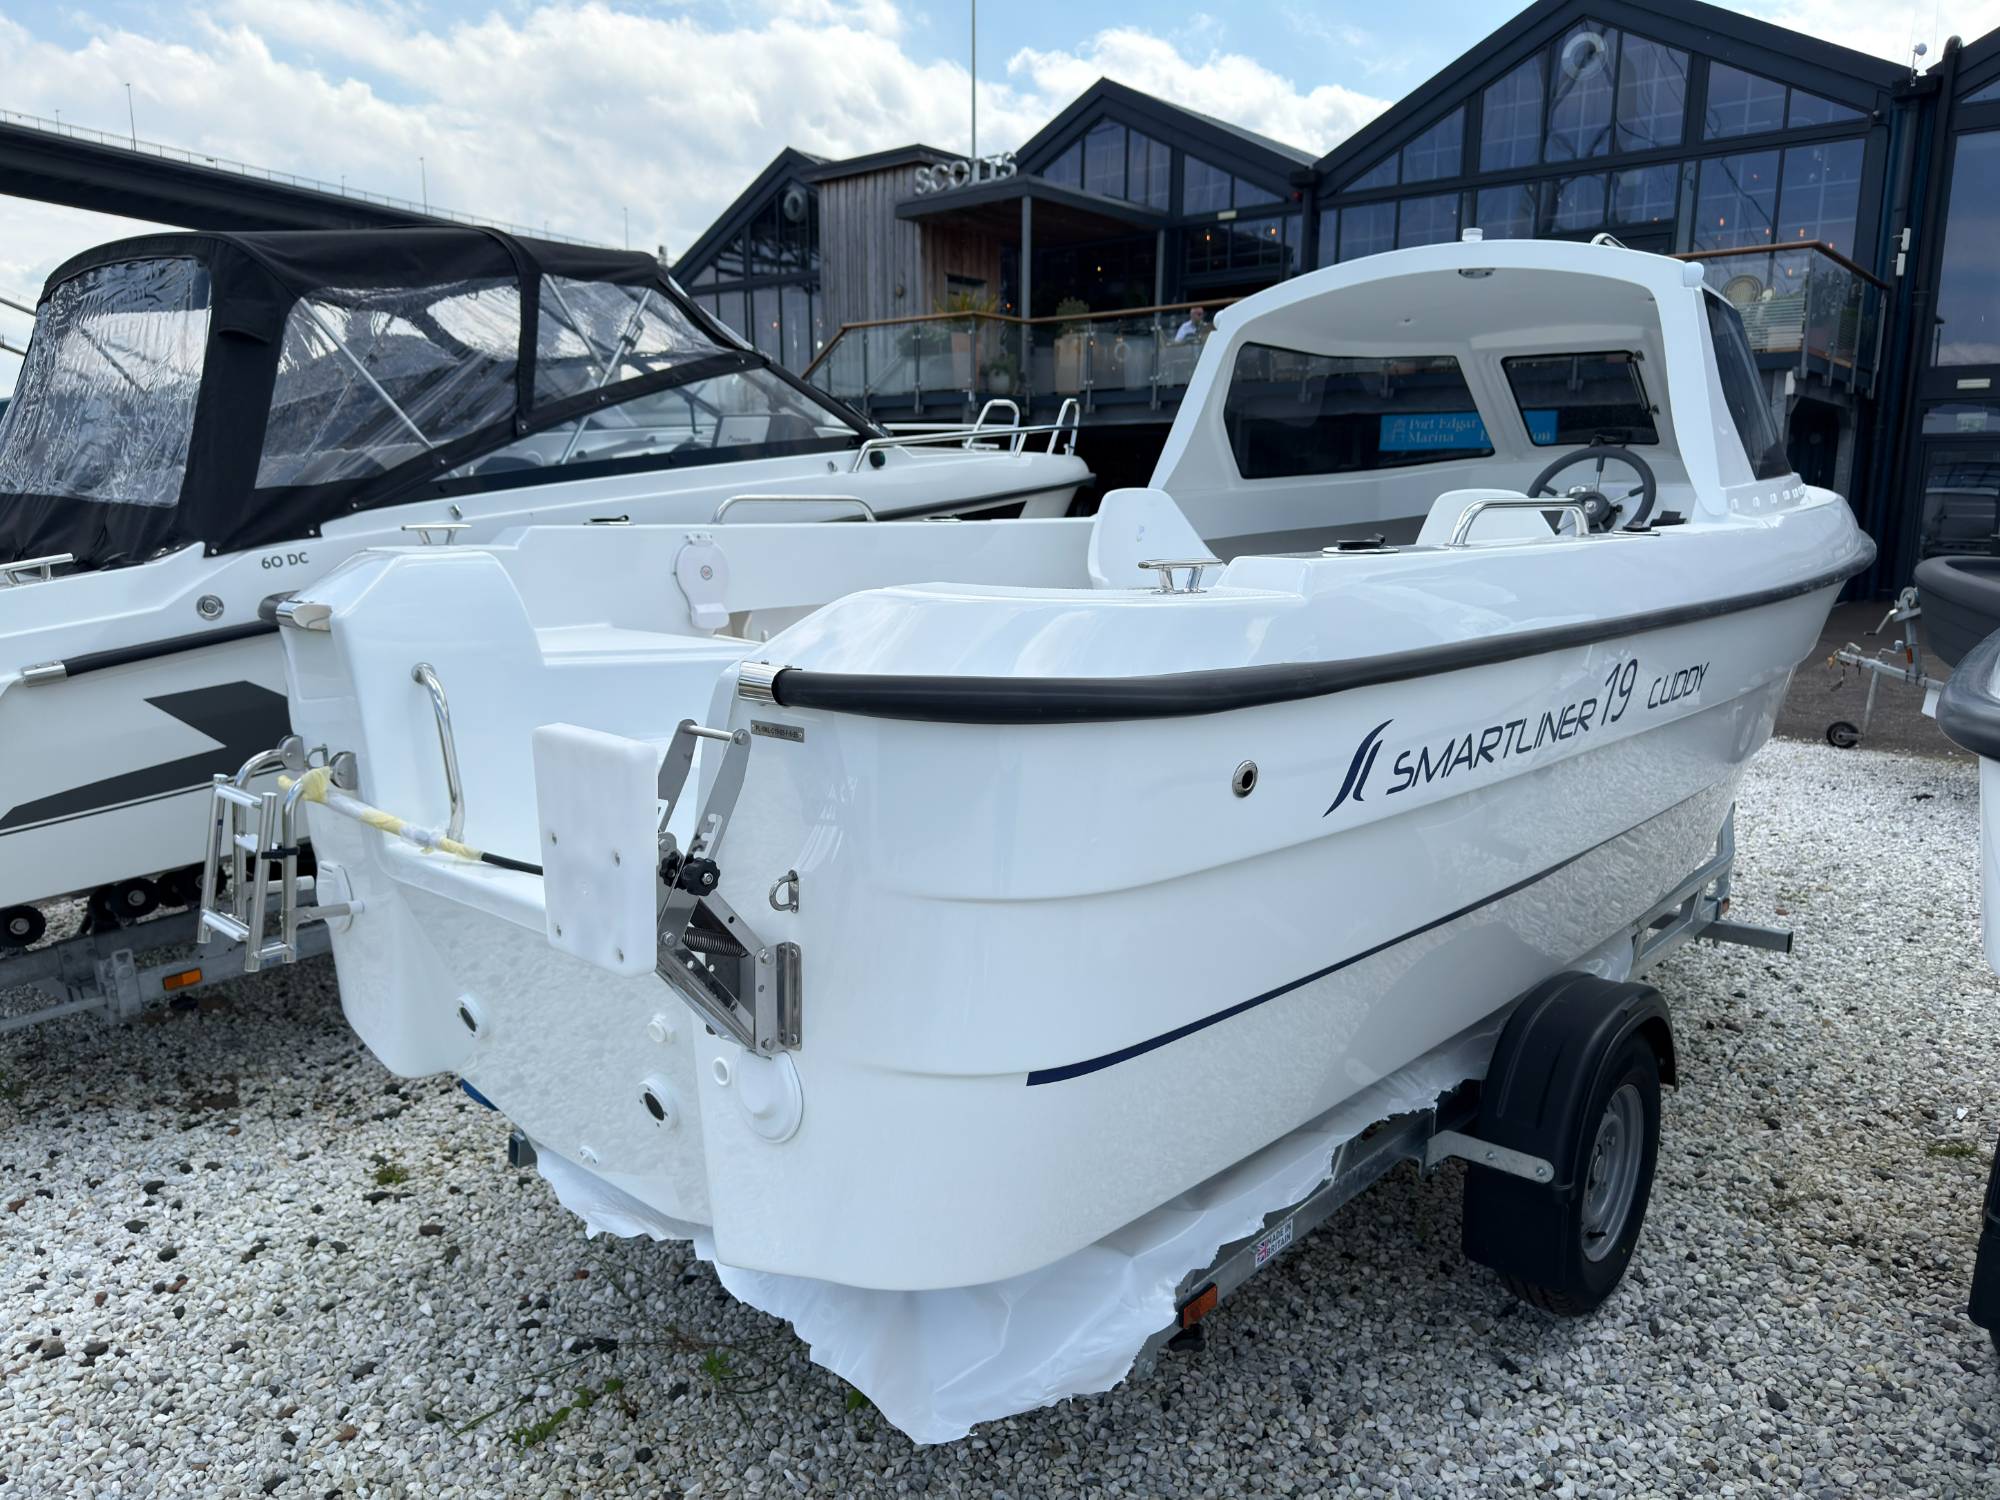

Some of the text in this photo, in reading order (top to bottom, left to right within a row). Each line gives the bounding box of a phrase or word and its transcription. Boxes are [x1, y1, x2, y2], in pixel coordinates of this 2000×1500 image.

[1409, 417, 1477, 432] Port Edgar
[1408, 431, 1454, 443] Marina
[261, 551, 309, 569] 60 DC
[1385, 658, 1710, 795] SMARTLINER 19 CUDDY
